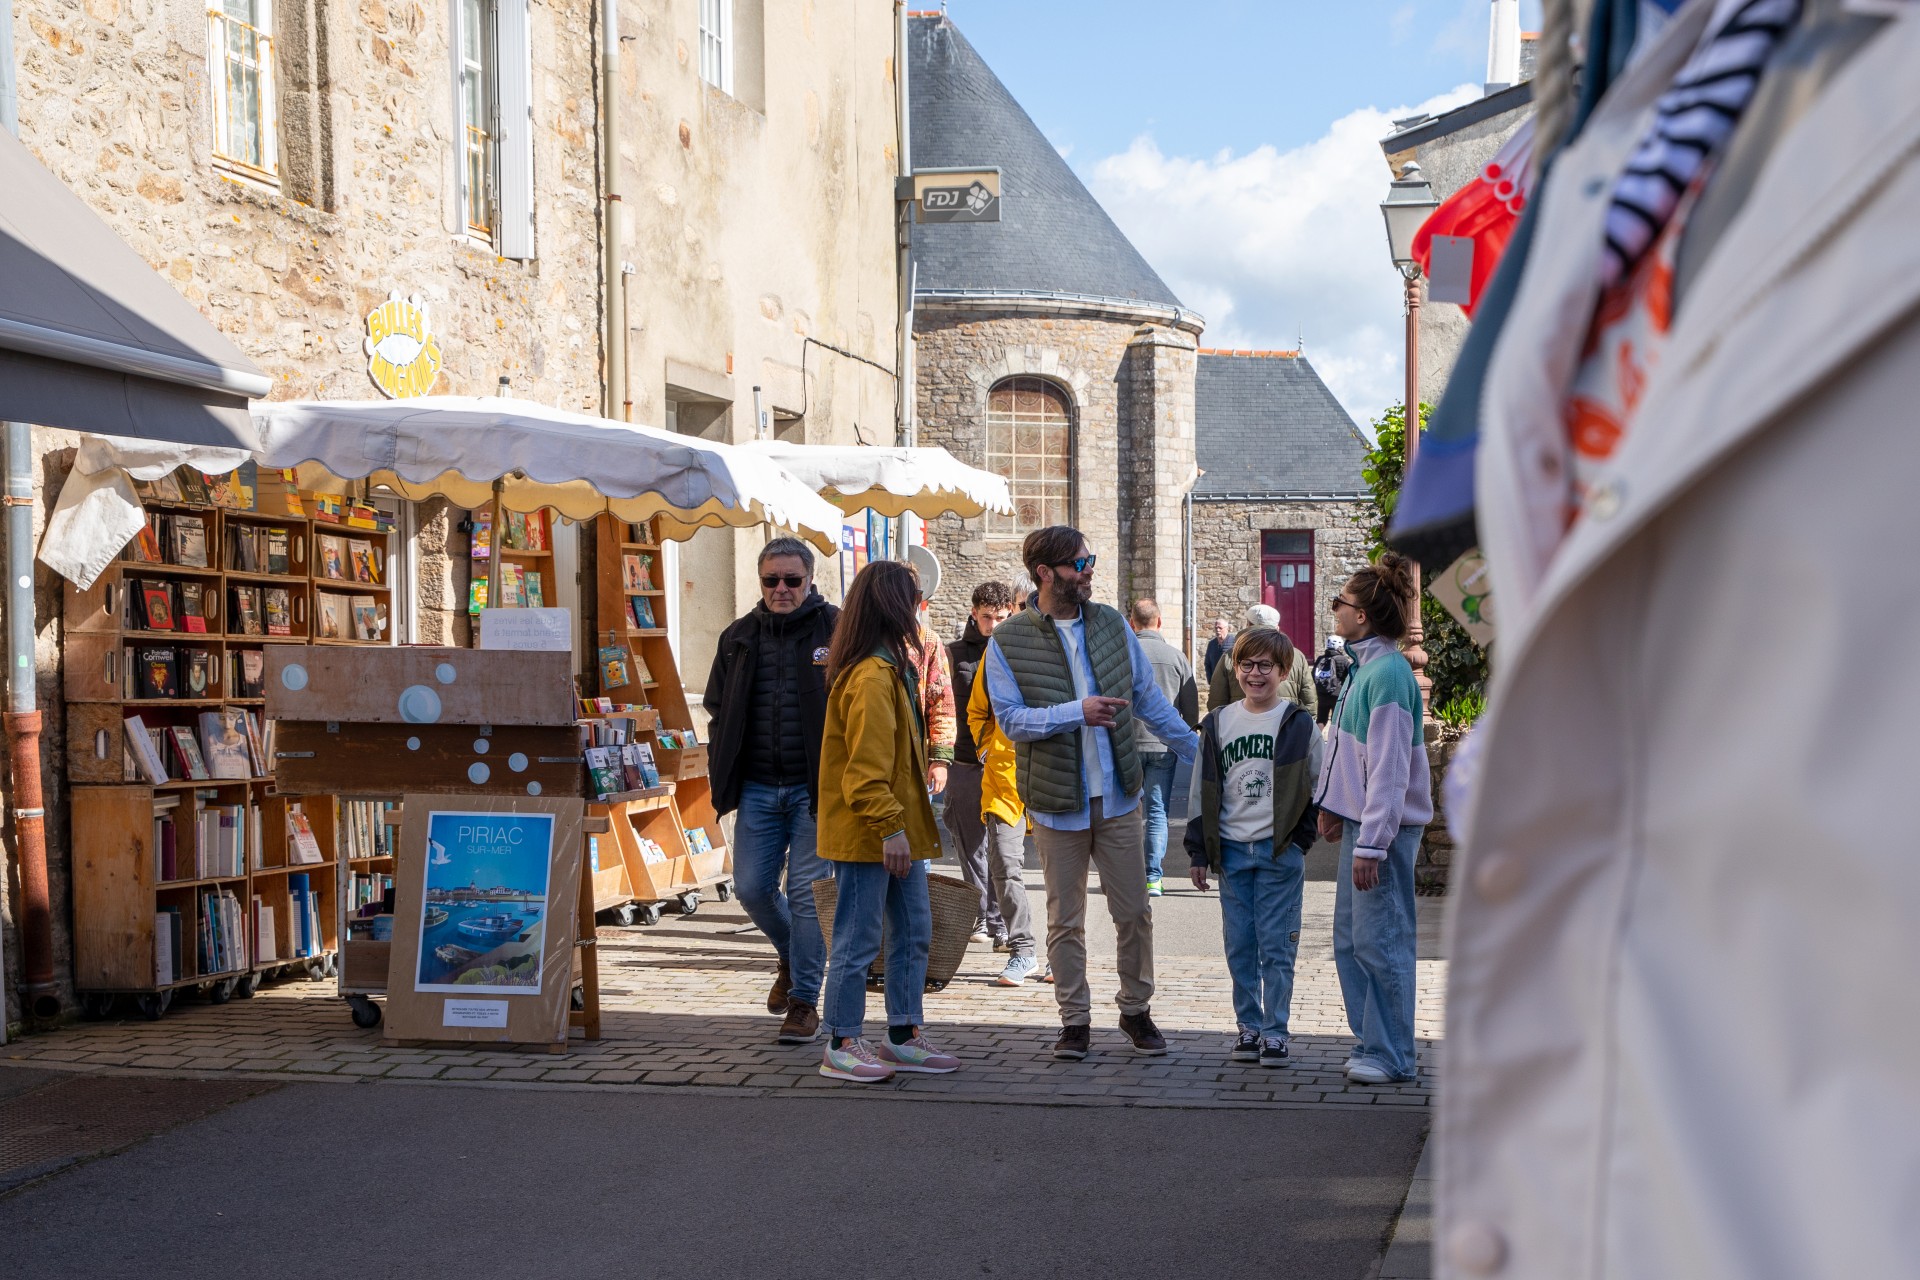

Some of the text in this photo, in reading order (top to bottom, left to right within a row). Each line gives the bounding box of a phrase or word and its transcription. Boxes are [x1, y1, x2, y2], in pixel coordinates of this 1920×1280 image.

[926, 191, 960, 206] FDJ
[368, 301, 424, 348] BULLES
[370, 332, 441, 399] MAGIQUES
[143, 652, 174, 661] Cornwell
[1220, 734, 1274, 780] UMMER
[1240, 769, 1253, 781] ENJOY
[1254, 769, 1266, 778] THE
[458, 825, 524, 845] PIRIAC
[466, 845, 512, 855] SUR-MER
